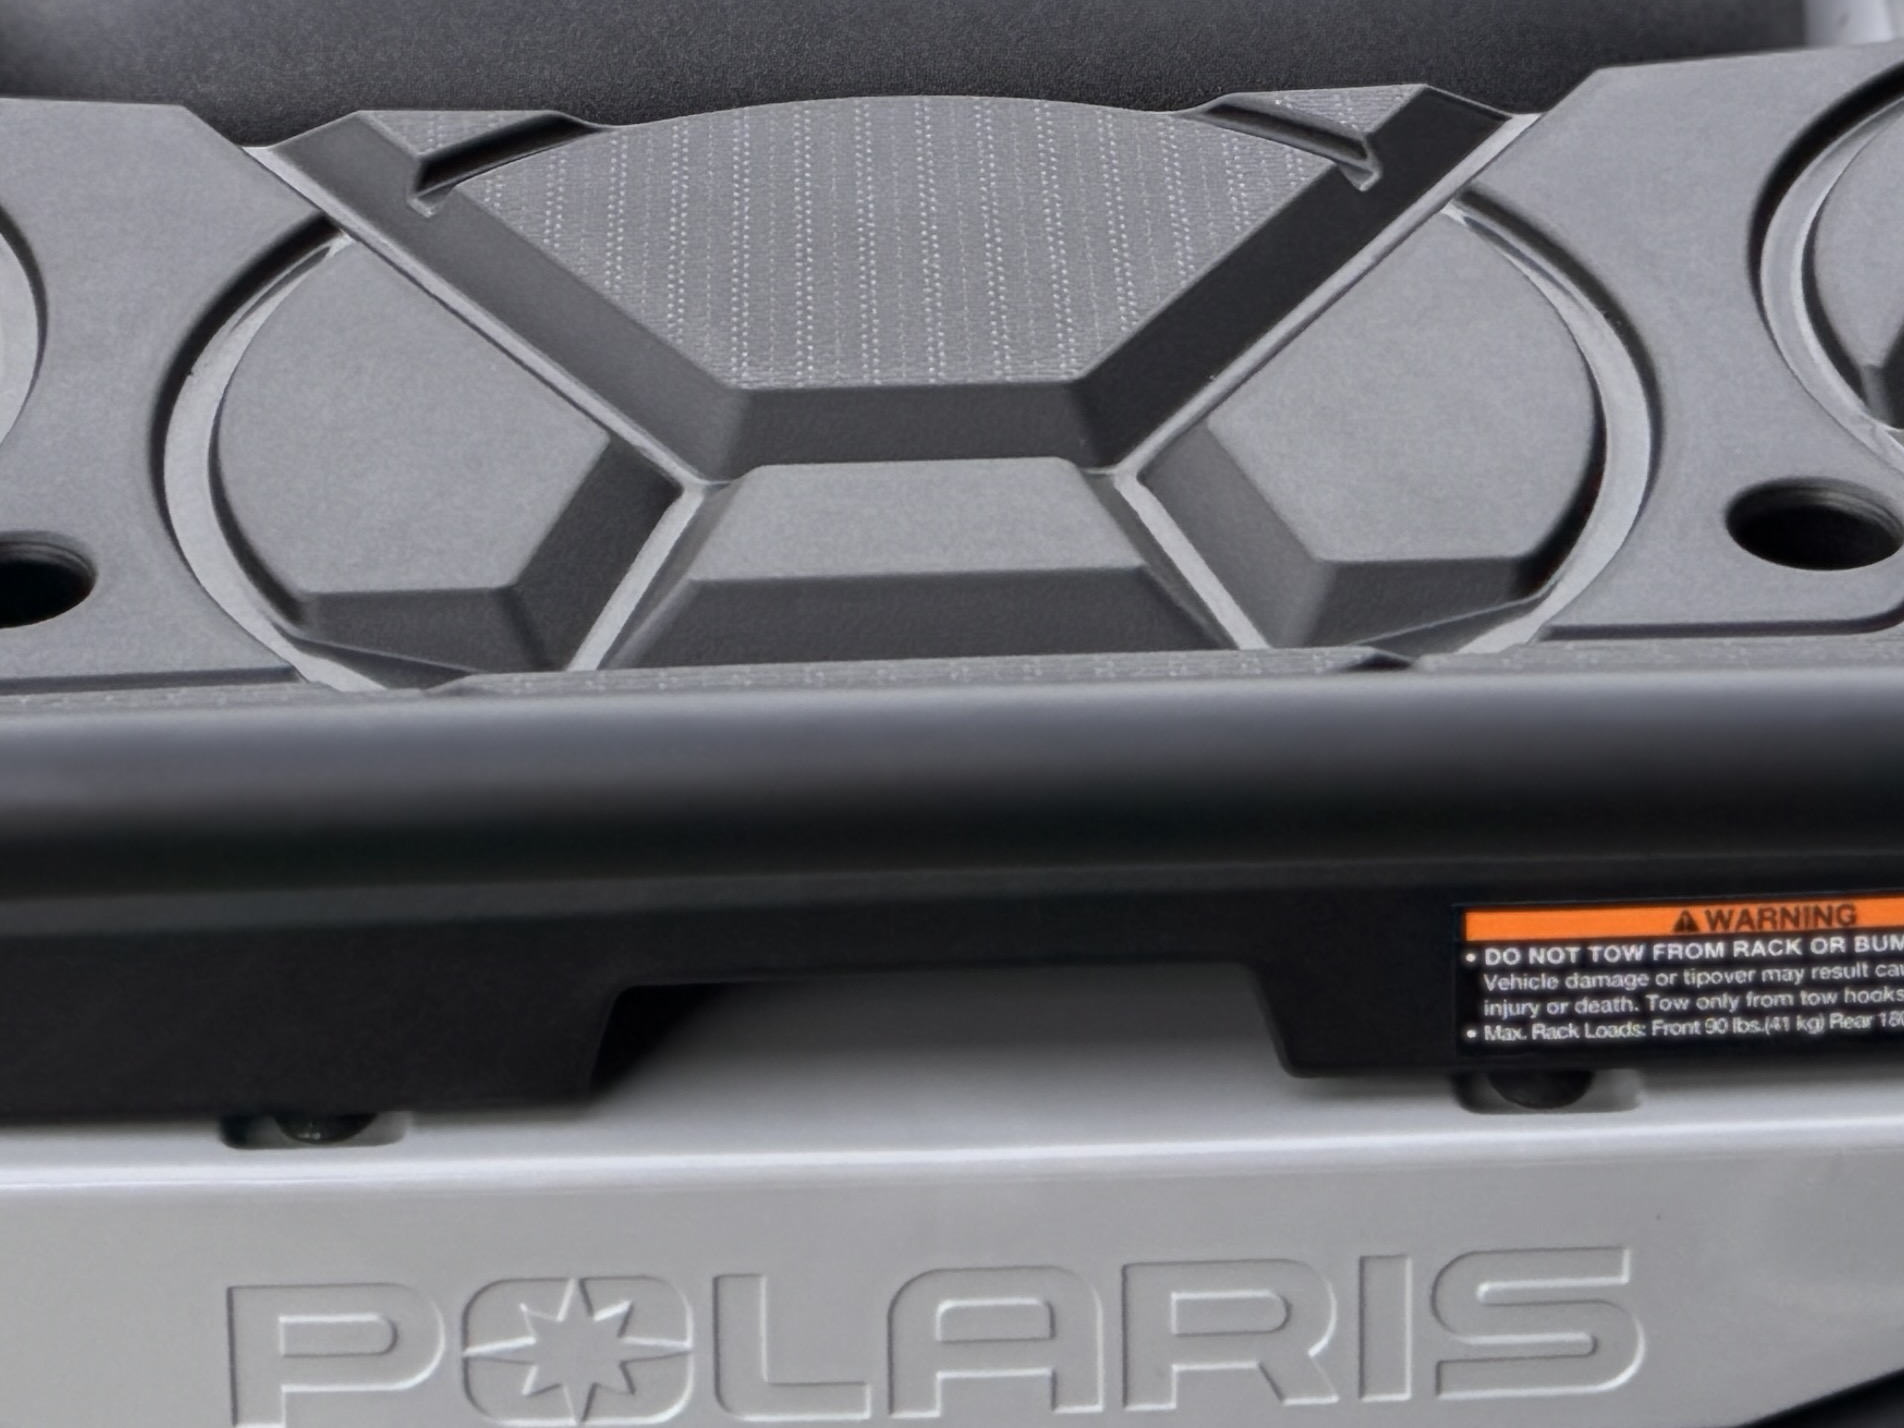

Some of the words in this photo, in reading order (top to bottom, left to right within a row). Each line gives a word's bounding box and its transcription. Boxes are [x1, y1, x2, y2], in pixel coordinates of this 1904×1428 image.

[1704, 903, 1857, 931] WARNING
[1484, 947, 1521, 966] DO
[1528, 946, 1581, 965] NOT
[1587, 944, 1645, 963] TOW
[1653, 941, 1725, 961] FROM
[1733, 938, 1803, 958] RACK
[1810, 936, 1846, 955] OR
[1483, 973, 1559, 992] Vehicle
[1565, 972, 1650, 991] damage
[1655, 974, 1678, 988] or
[1683, 968, 1755, 988] tipover
[1761, 967, 1804, 985] may
[1811, 963, 1869, 980] result
[1484, 999, 1539, 1020] injury
[1547, 1001, 1569, 1015] or
[1574, 996, 1639, 1014] death.
[1646, 994, 1690, 1011] Tow
[1696, 992, 1739, 1013] only
[1746, 991, 1794, 1007] from
[1800, 990, 1837, 1004] tow
[1484, 1025, 1527, 1041] Max.
[1532, 1022, 1580, 1040] Rack
[1584, 1021, 1646, 1038] Loads:
[1651, 1019, 1701, 1036] Front
[1705, 1017, 1728, 1034] 90
[1796, 1014, 1825, 1035] kg)
[1829, 1011, 1872, 1029] Rear
[226, 1246, 1646, 1428] POLARIS
